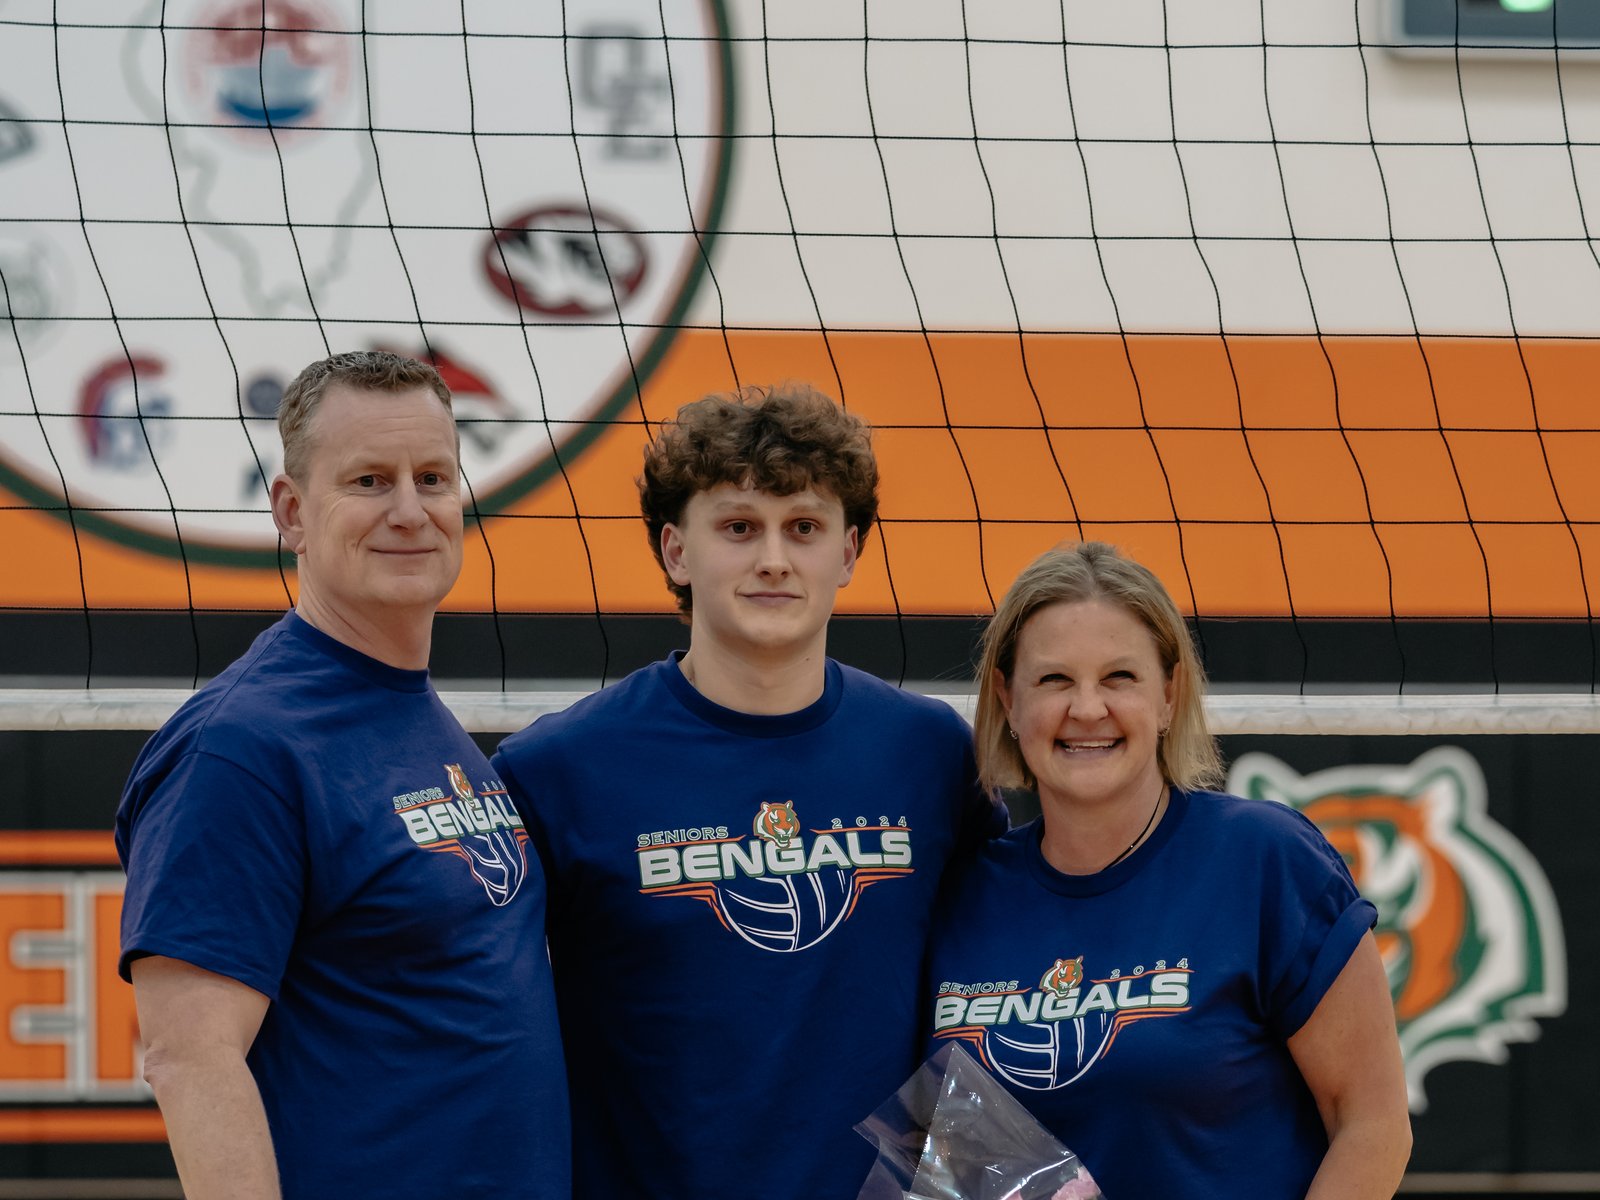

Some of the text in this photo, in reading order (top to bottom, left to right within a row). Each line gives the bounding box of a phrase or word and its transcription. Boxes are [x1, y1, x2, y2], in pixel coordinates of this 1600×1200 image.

[393, 787, 445, 809] SENIORS
[400, 794, 524, 845] BENGAL
[637, 815, 908, 847] SENIORS 2024
[638, 830, 912, 888] BENGALS
[938, 957, 1189, 996] SENIORS 2024
[934, 971, 1190, 1031] BENGALS
